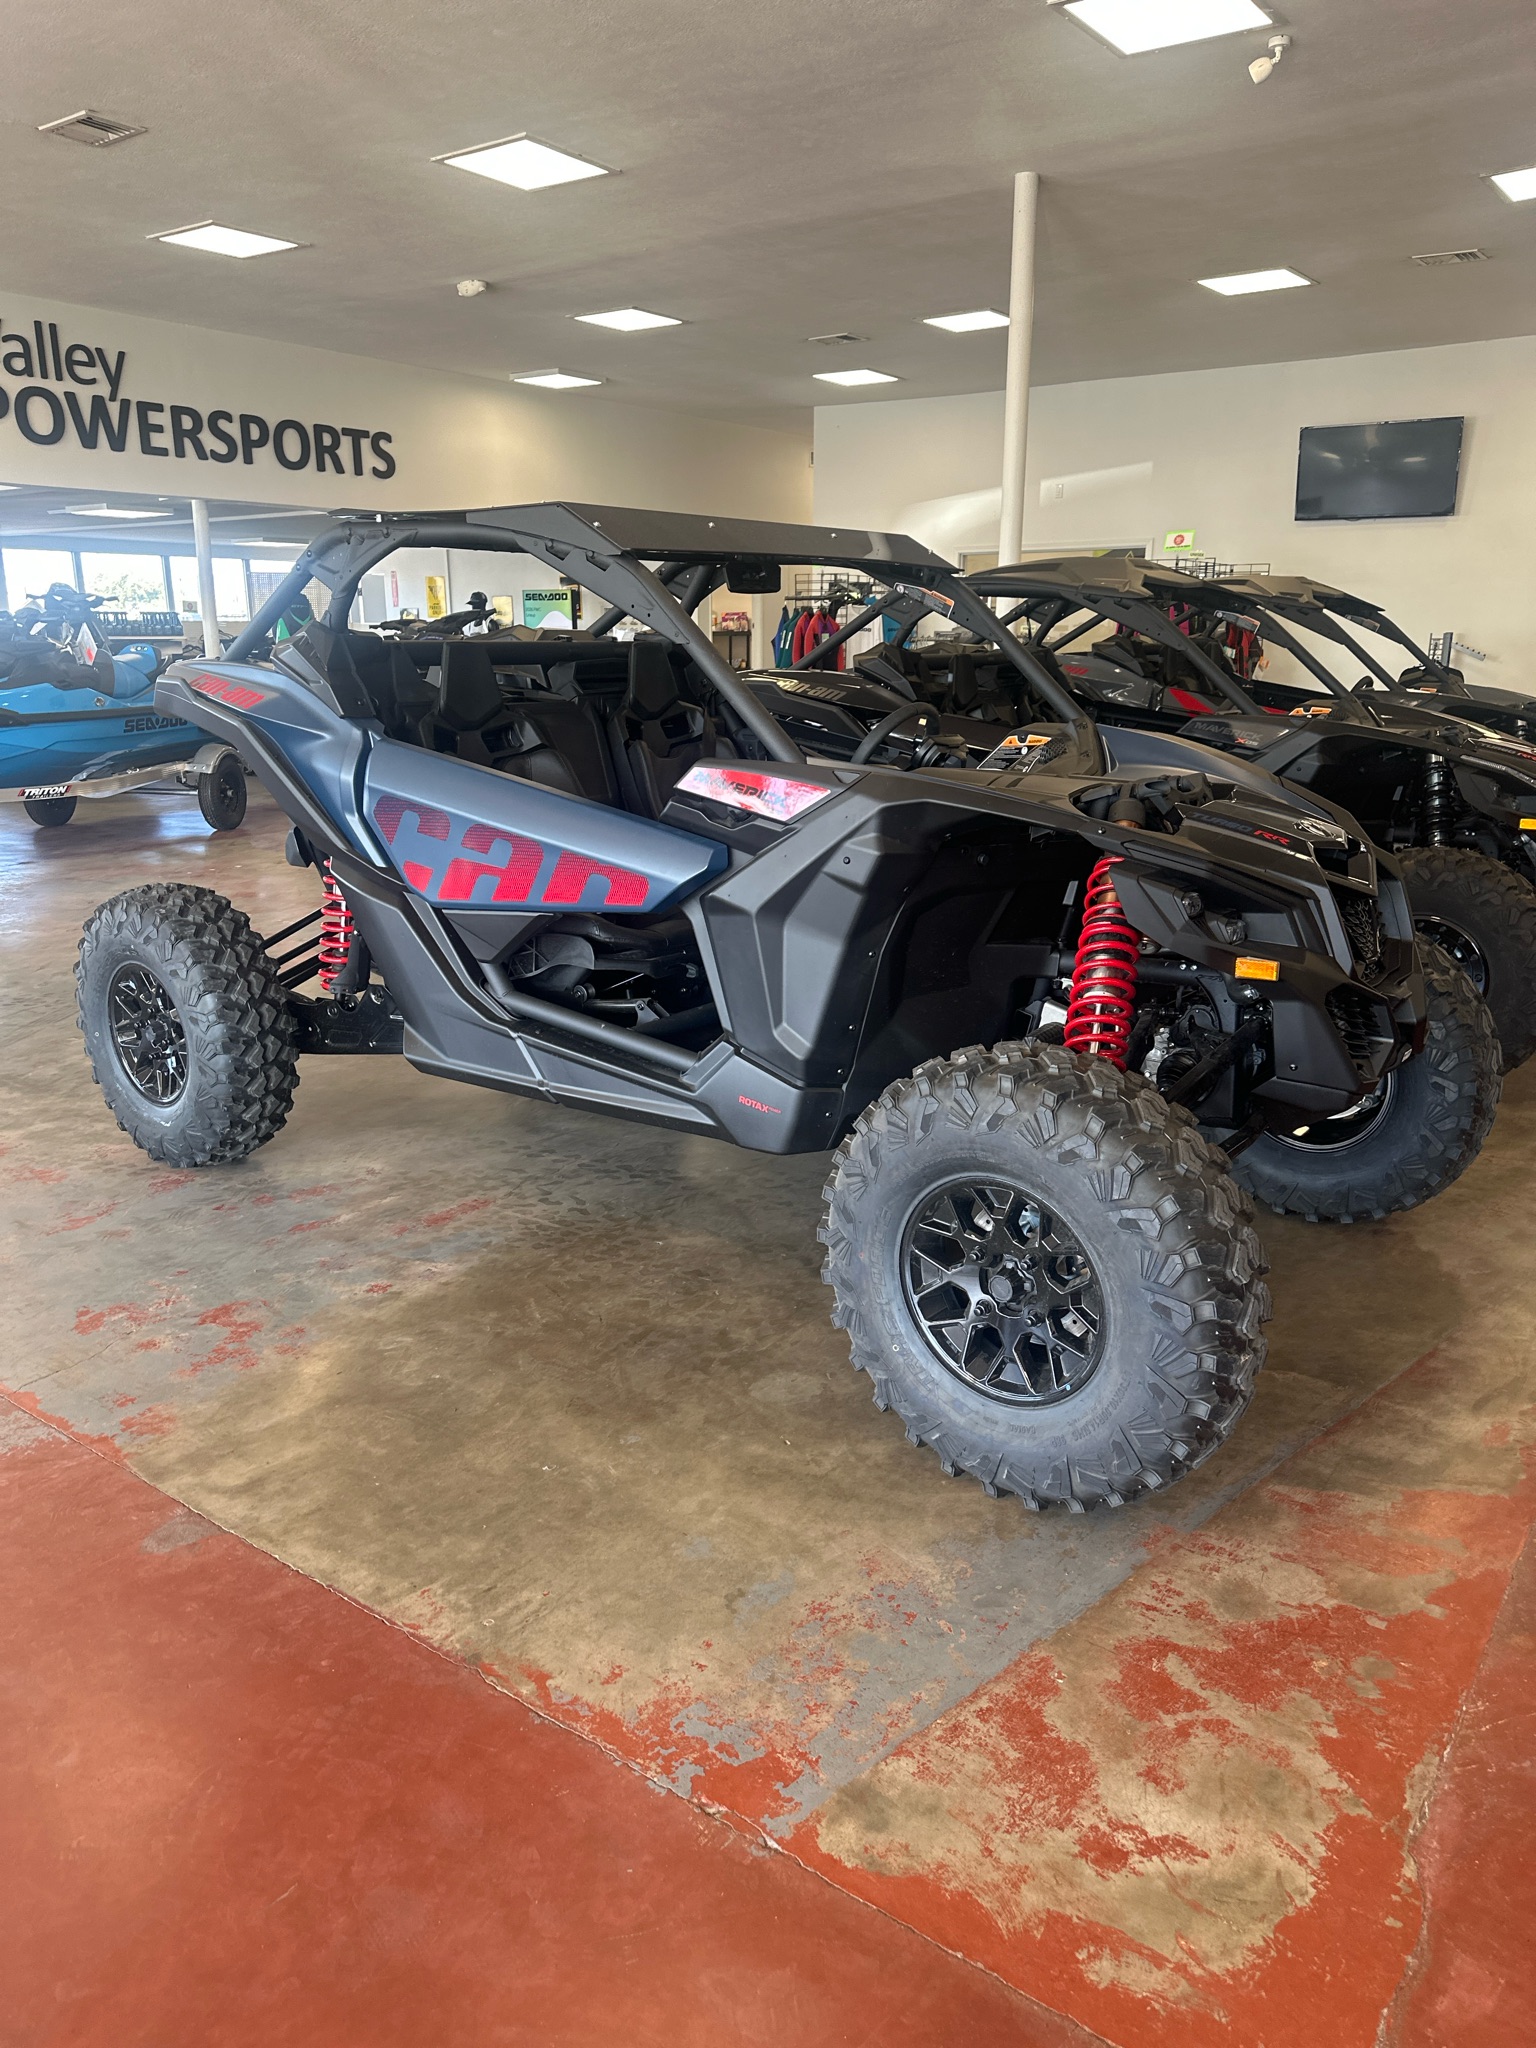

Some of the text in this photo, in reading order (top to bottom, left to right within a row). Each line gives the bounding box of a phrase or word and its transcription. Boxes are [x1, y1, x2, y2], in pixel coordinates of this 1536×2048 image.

[0, 318, 126, 402] alley
[1194, 721, 1264, 742] MAVERICK
[24, 785, 68, 797] TRITON
[1192, 812, 1290, 845] TURBO RR
[738, 1094, 769, 1113] ROTAX
